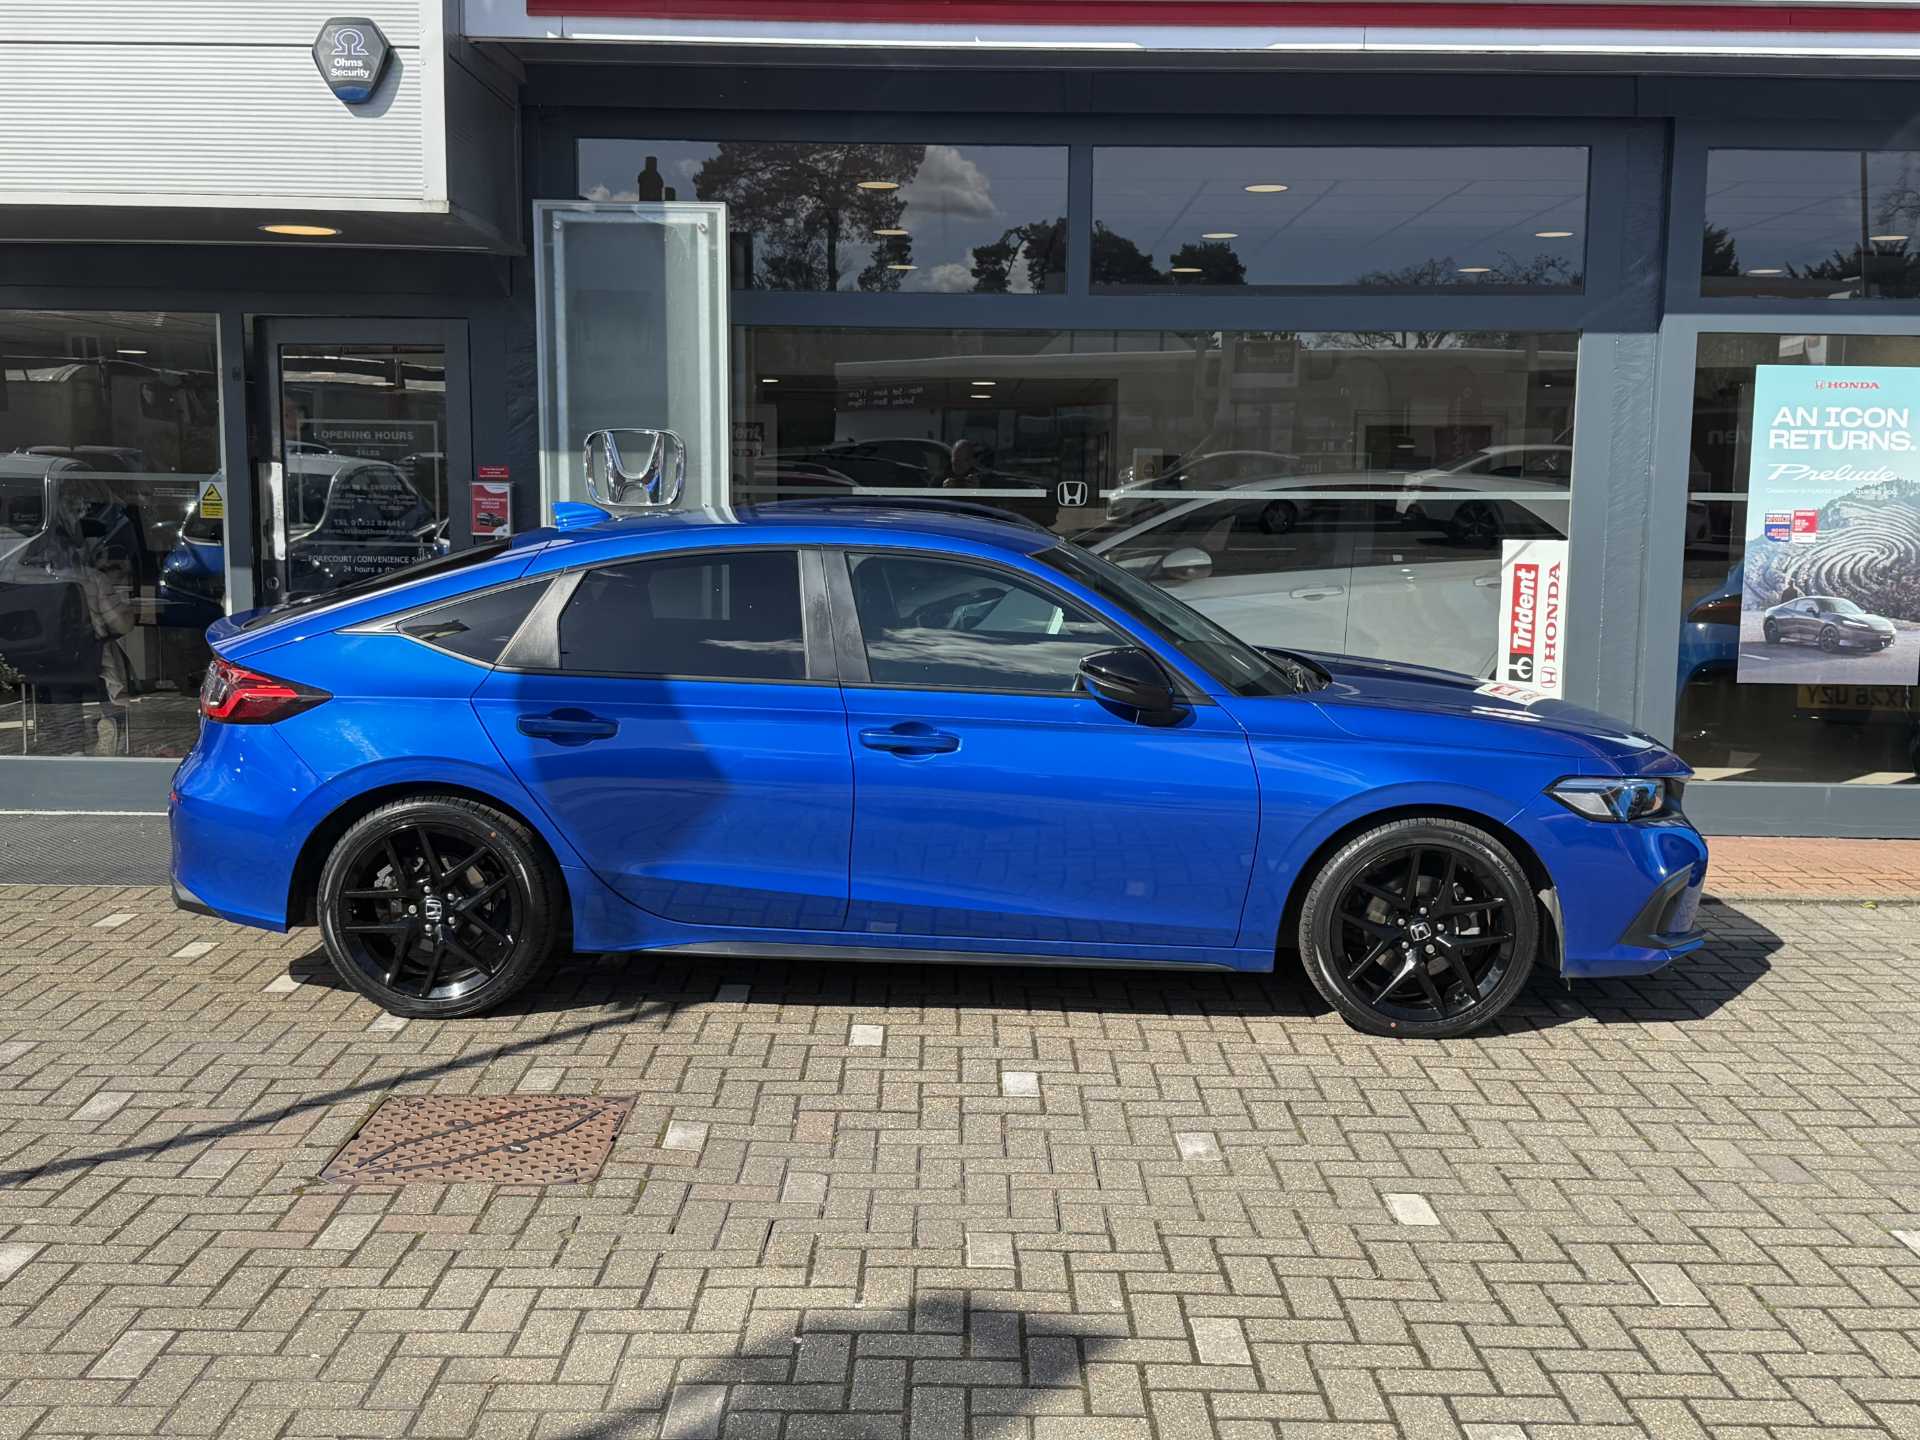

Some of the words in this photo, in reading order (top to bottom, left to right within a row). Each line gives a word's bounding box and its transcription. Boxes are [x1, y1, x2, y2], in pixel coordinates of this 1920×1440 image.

[334, 58, 363, 67] Ohms
[330, 68, 370, 78] Security
[1828, 381, 1880, 390] HONDA
[1771, 406, 1818, 427] AN
[1824, 407, 1910, 428] ICON
[320, 430, 371, 440] OPENING
[375, 431, 414, 441] HOURS
[1768, 429, 1918, 451] RETURNS.
[1767, 464, 1898, 482] Prelude
[1544, 561, 1561, 663] HONDA
